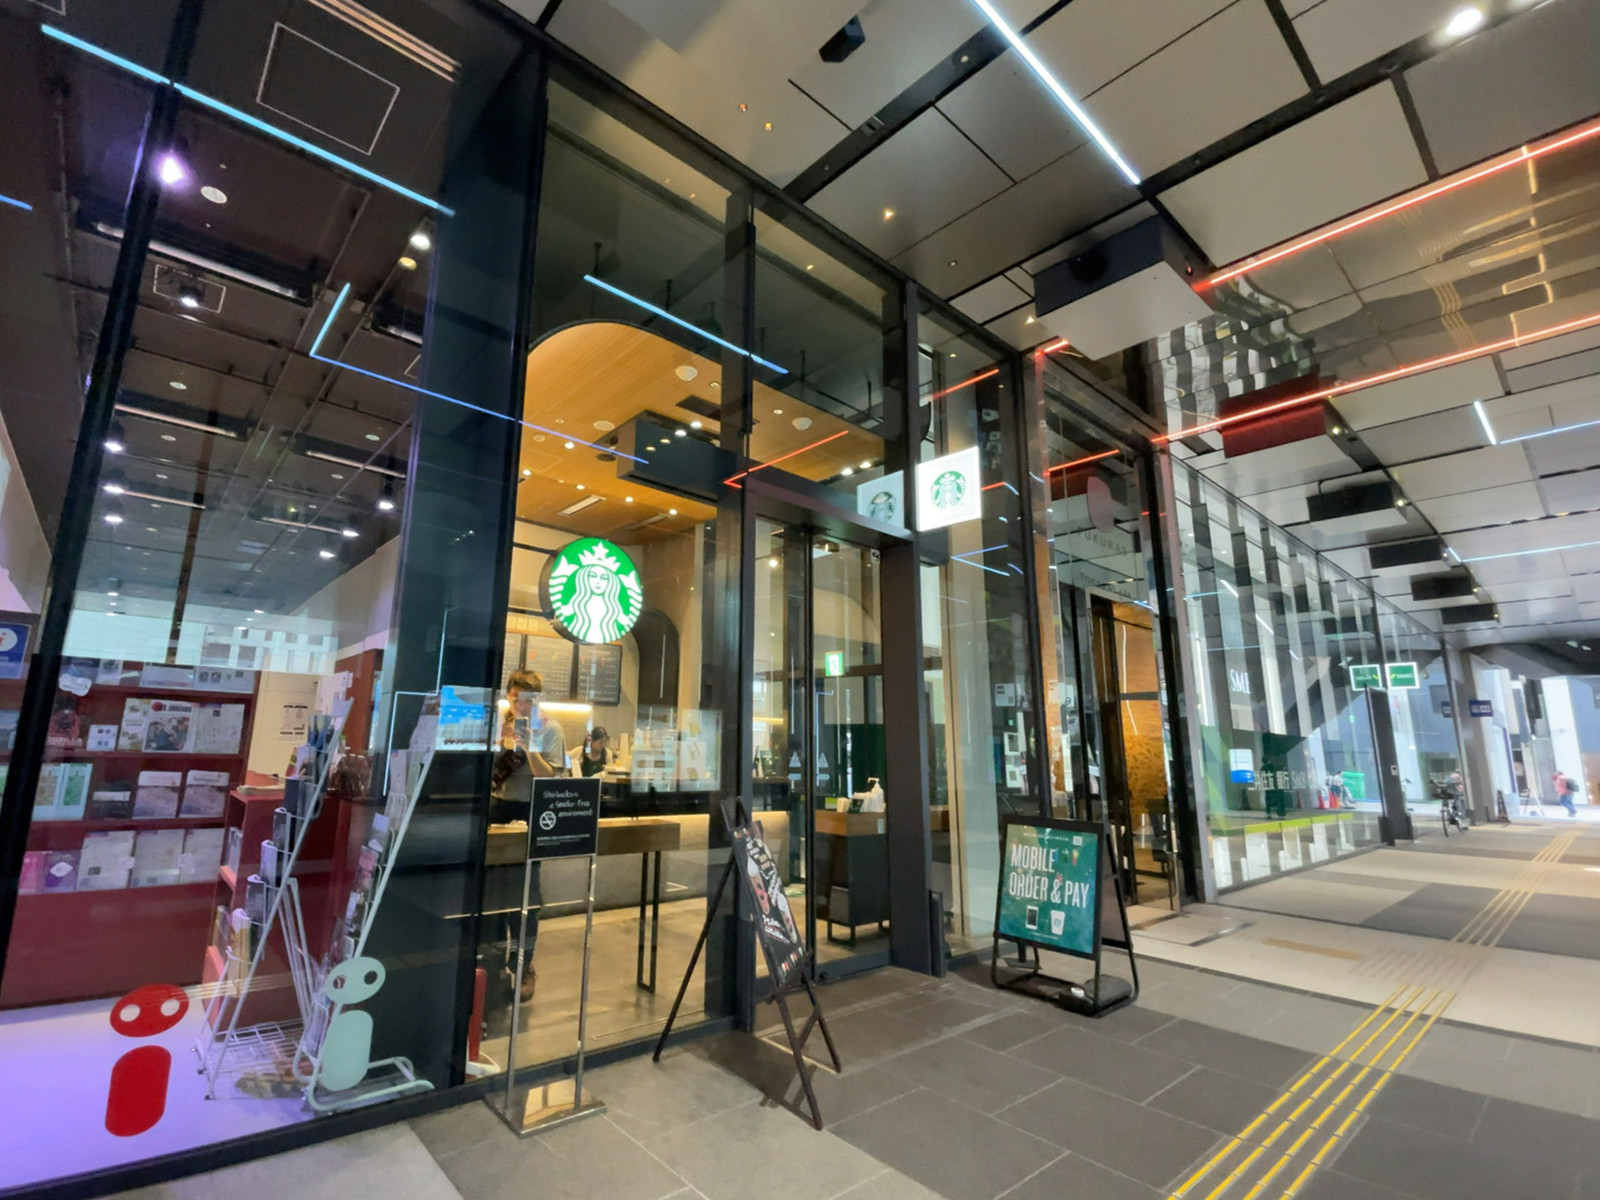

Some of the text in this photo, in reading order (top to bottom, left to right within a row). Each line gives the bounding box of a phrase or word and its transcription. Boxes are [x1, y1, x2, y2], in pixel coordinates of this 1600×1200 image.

[1011, 845, 1056, 872] MOBILE
[1009, 873, 1090, 908] ORDER & PAY
